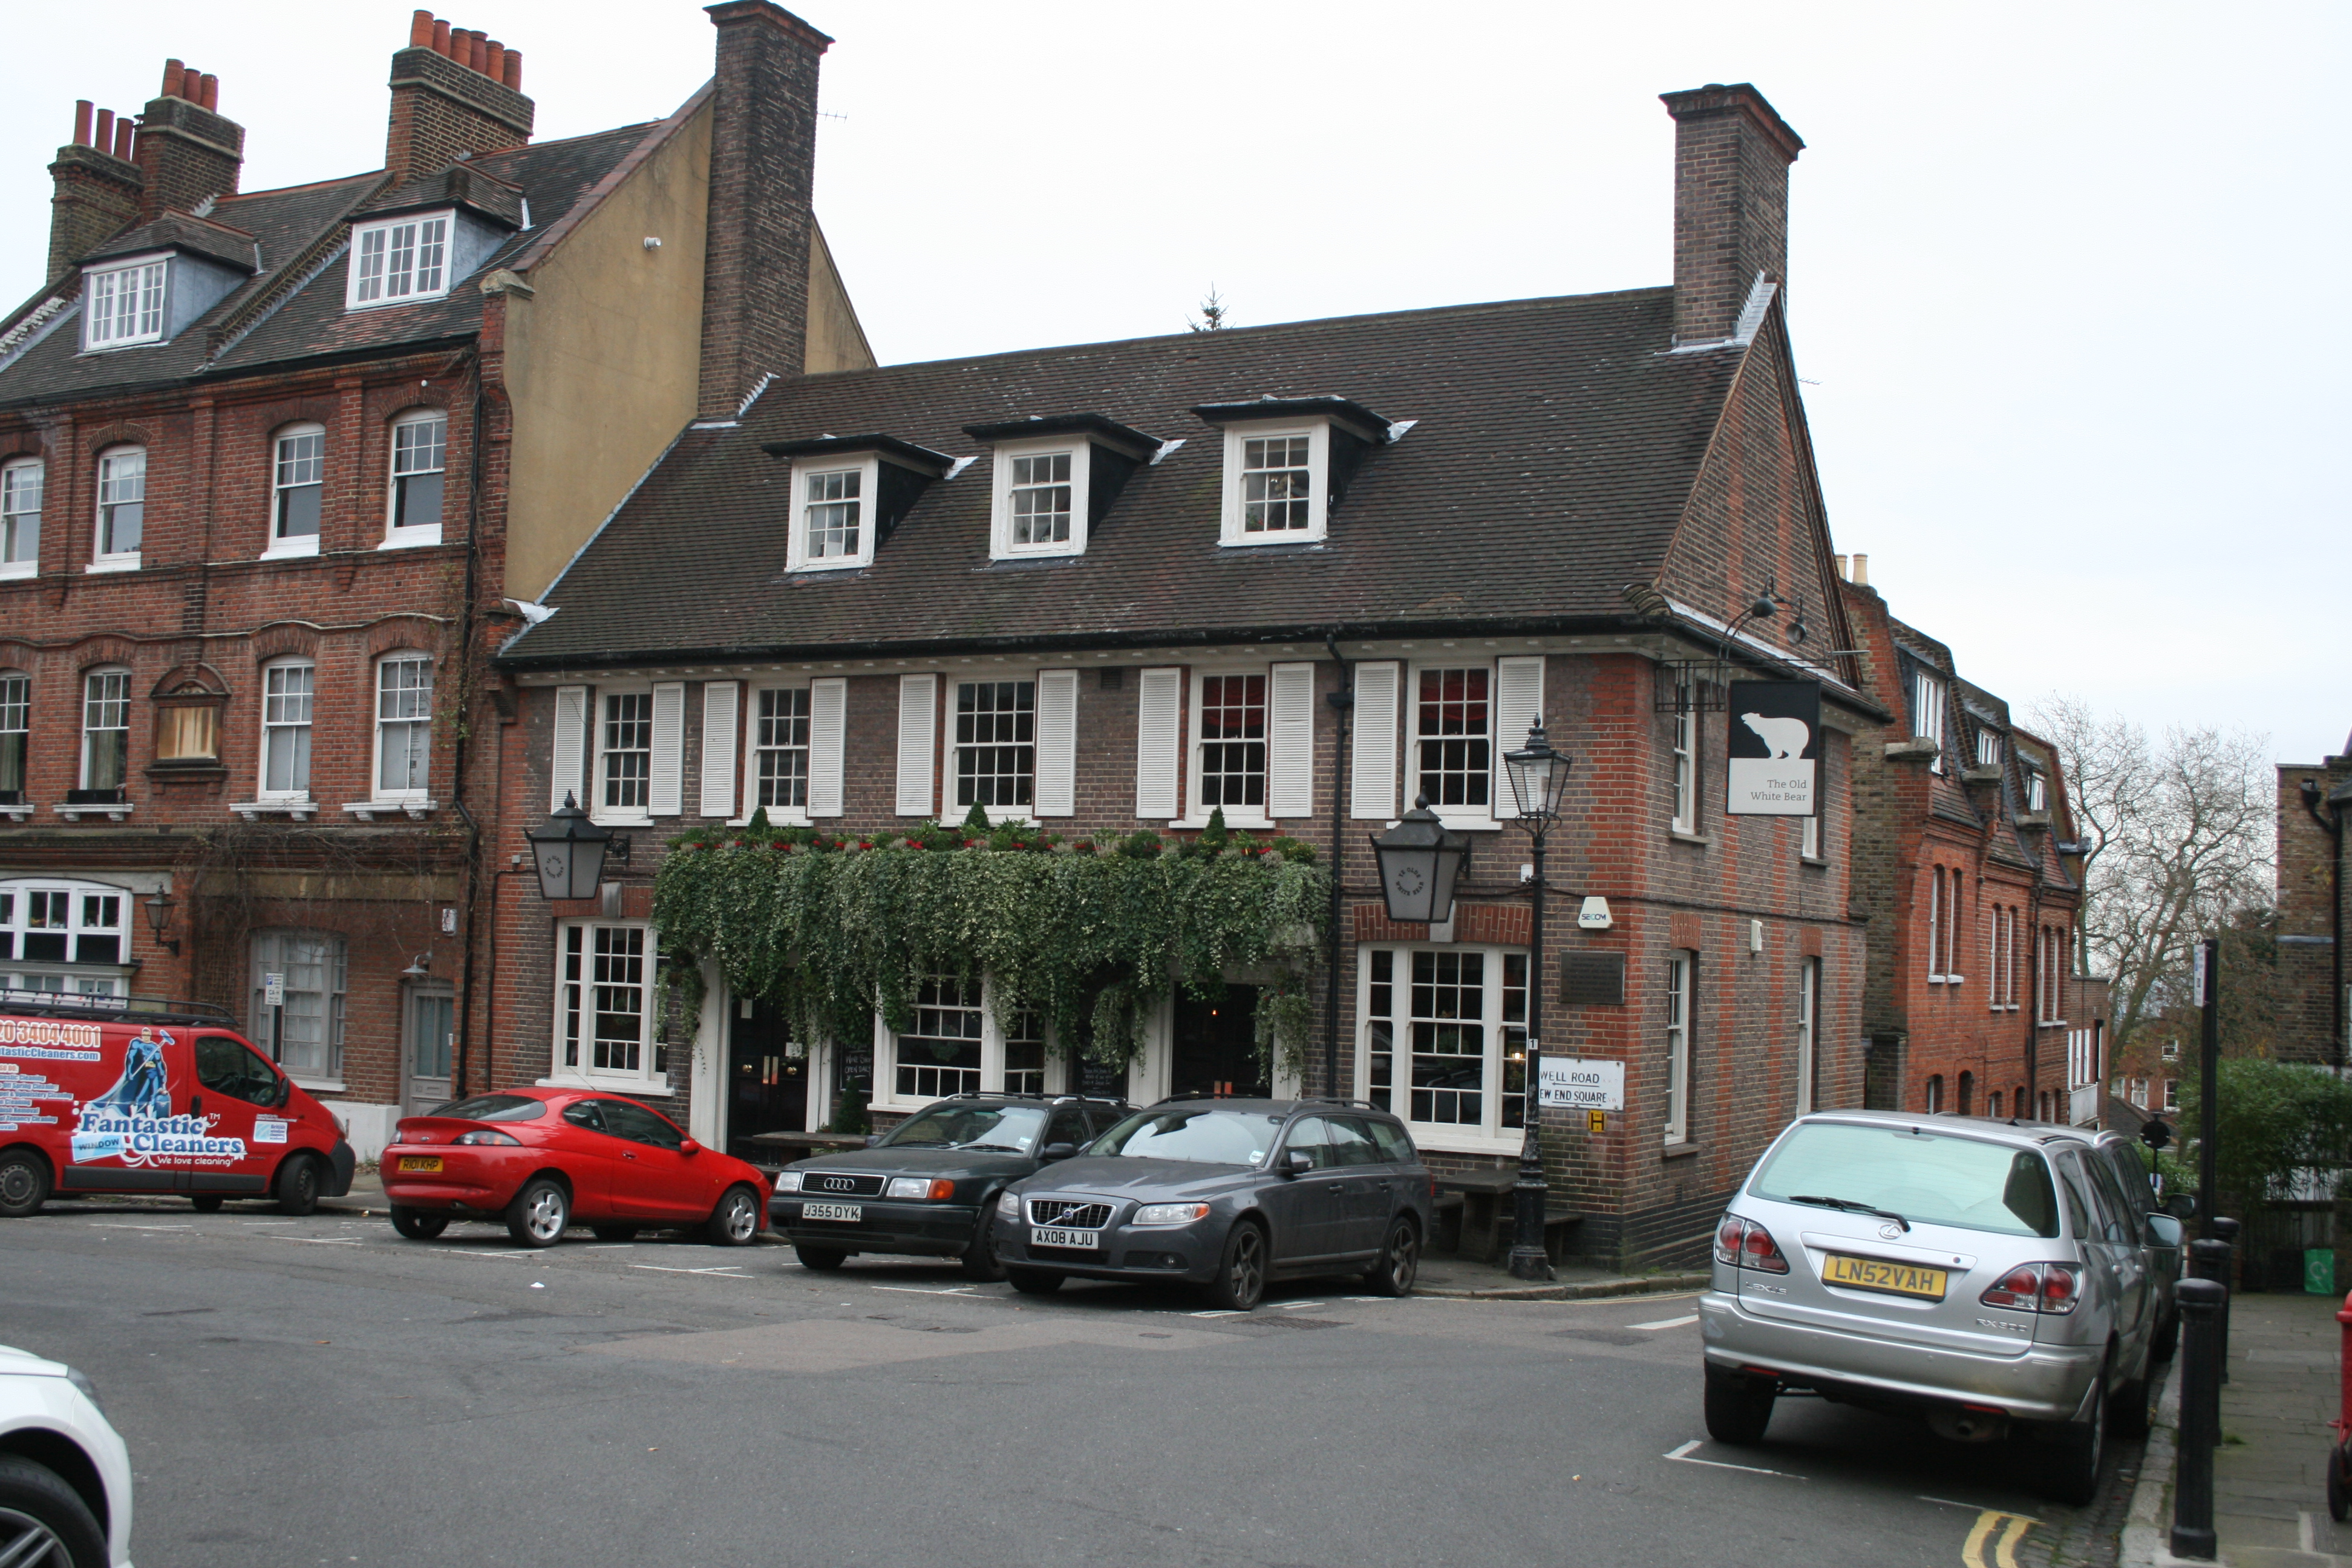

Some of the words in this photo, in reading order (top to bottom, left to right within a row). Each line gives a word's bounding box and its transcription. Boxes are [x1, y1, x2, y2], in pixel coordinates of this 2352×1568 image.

[1766, 779, 1786, 788] The
[1789, 779, 1807, 789] Old
[1750, 791, 1781, 800] White
[1784, 792, 1807, 801] Bear
[1406, 867, 1421, 878] OLDE
[1396, 881, 1410, 896] WHITE
[18, 1022, 60, 1045] 3404
[62, 1024, 101, 1047] 4001
[1530, 1039, 1534, 1048] 1
[1540, 1071, 1567, 1082] WELL
[1571, 1072, 1599, 1083] ROAD
[1540, 1089, 1552, 1099] EW
[1554, 1089, 1572, 1100] END
[1573, 1091, 1607, 1103] SQUARE
[81, 1112, 203, 1134] Fantastic
[79, 1138, 119, 1151] WINDOW
[133, 1133, 243, 1154] Cleaners
[157, 1155, 172, 1164] We
[174, 1156, 192, 1165] love
[194, 1157, 234, 1167] cleaning!
[402, 1158, 419, 1169] R101
[420, 1159, 439, 1170] KHP
[804, 1204, 832, 1217] J355
[835, 1206, 859, 1219] DYK
[1036, 1230, 1066, 1244] AX08
[1070, 1232, 1093, 1246] AJU
[1834, 1259, 1934, 1292] LN52VAH
[1746, 1281, 1787, 1295] LEXUS
[1998, 1321, 2027, 1331] 300
